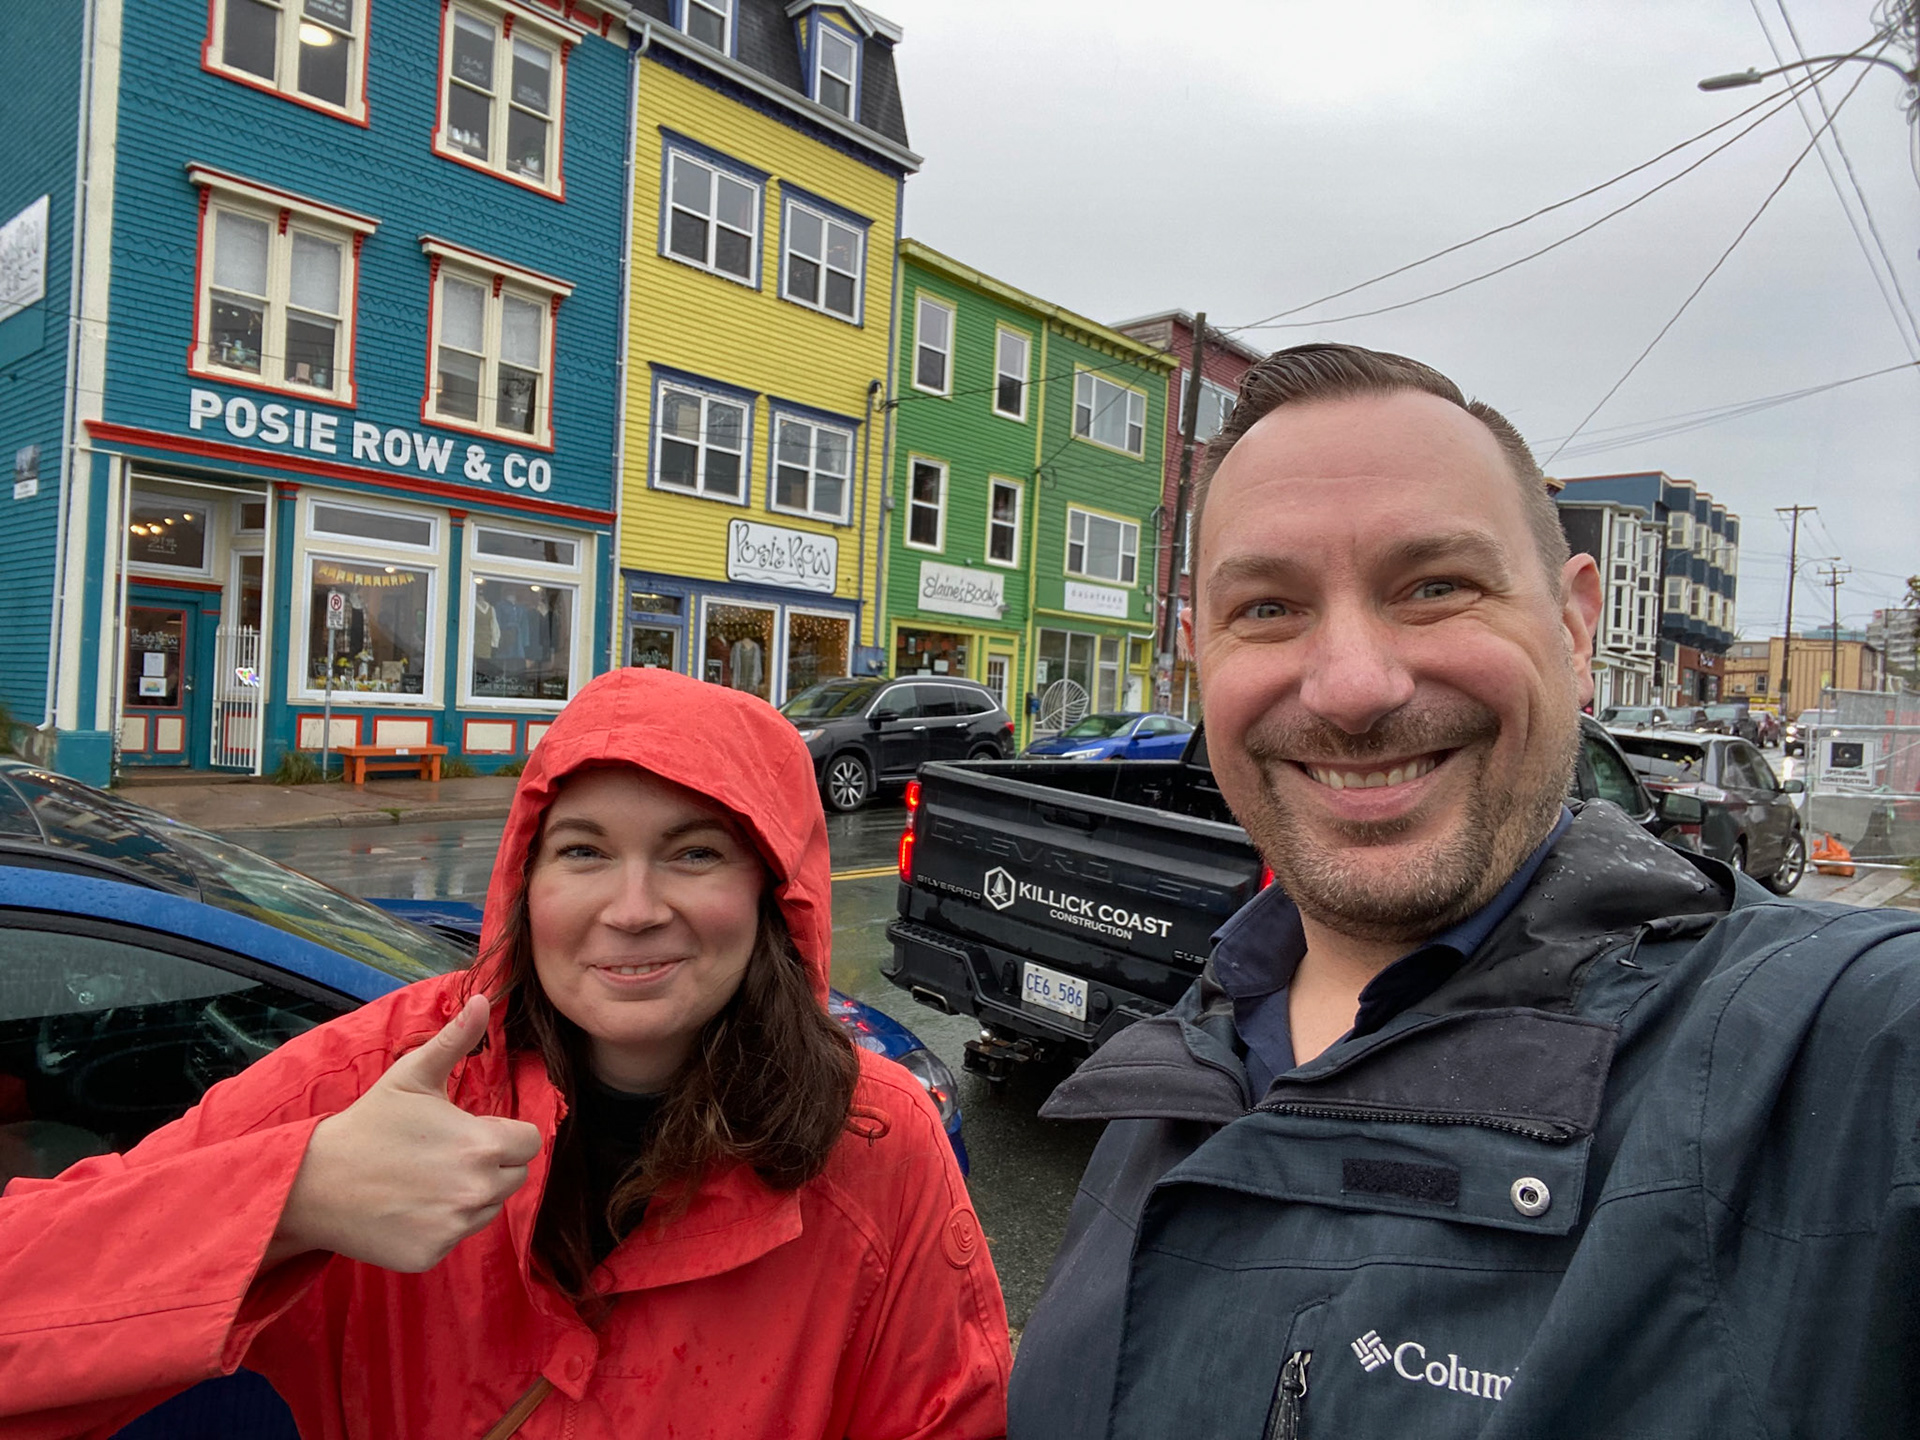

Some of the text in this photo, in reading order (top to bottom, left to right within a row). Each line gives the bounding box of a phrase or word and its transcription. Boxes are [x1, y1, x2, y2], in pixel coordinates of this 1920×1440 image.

[189, 388, 551, 493] POSIE ROW & CO
[735, 523, 831, 579] Posie Row
[963, 579, 999, 607] Books
[917, 874, 981, 900] SILVERADO
[1019, 882, 1173, 938] KILLICK COAST
[1050, 909, 1133, 940] CONSTRUCTION
[1173, 950, 1208, 965] CUS
[1026, 973, 1050, 996] CE6
[1059, 983, 1083, 1007] 586
[1393, 1341, 1513, 1401] Colum
